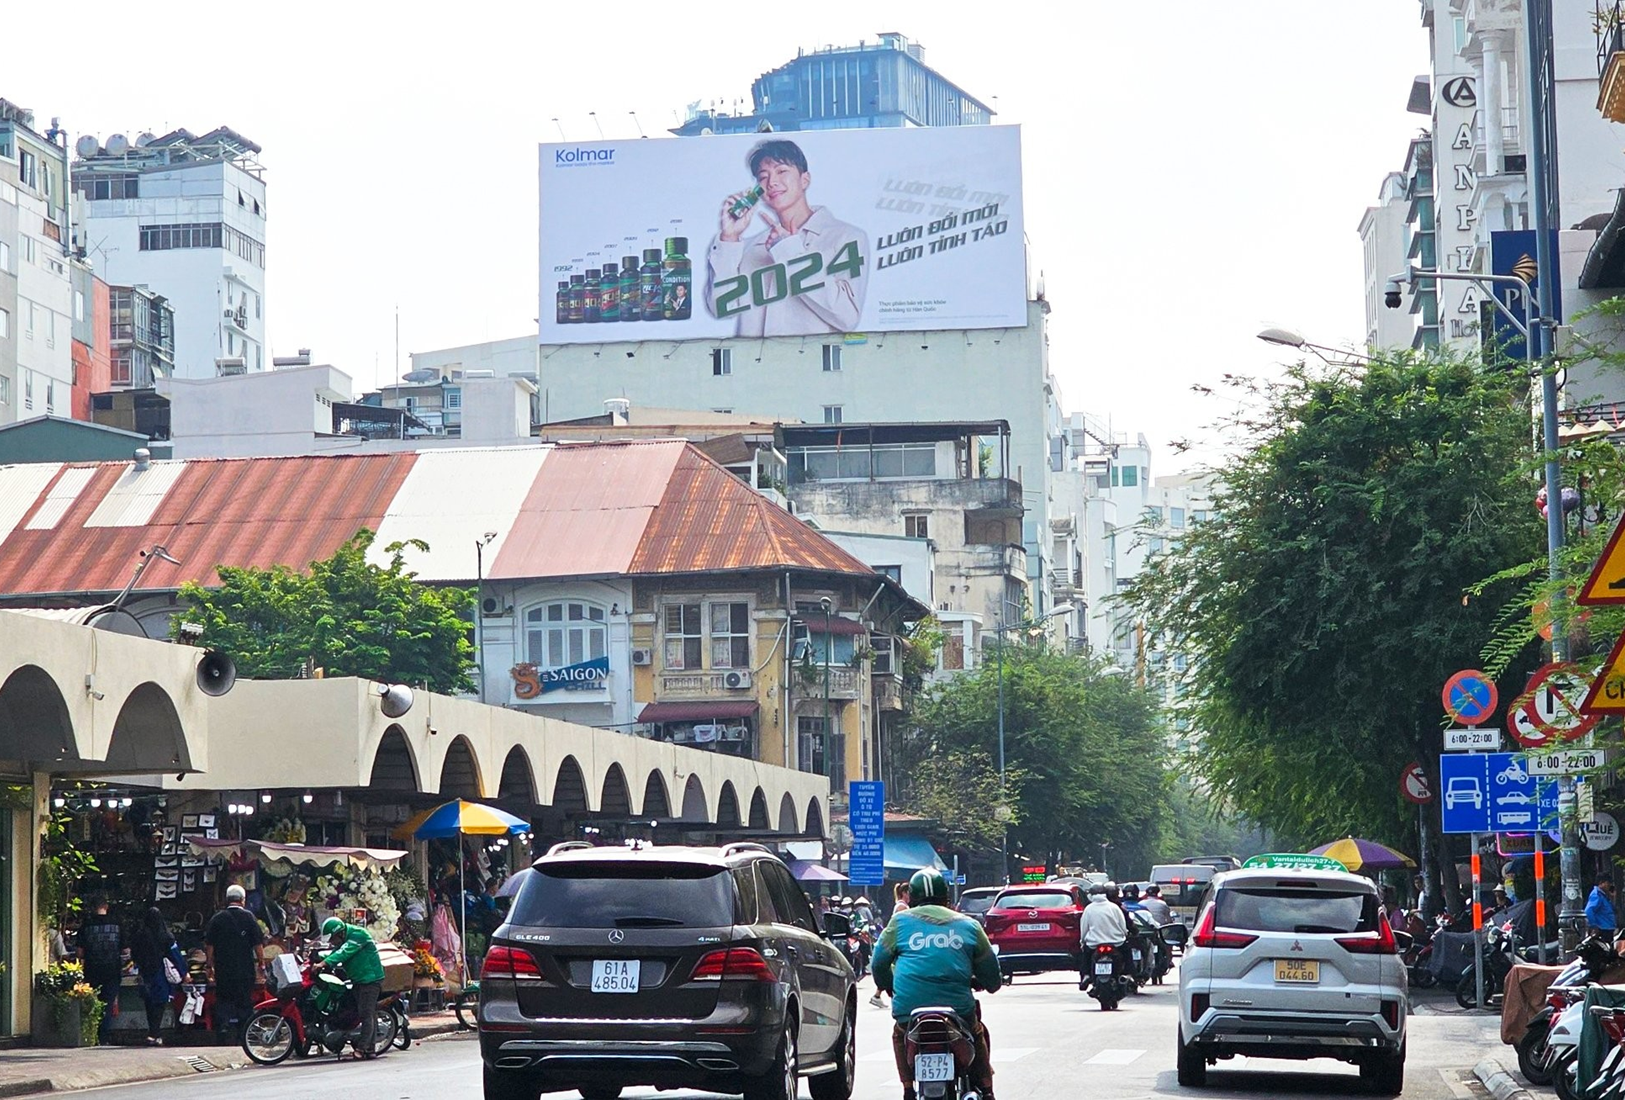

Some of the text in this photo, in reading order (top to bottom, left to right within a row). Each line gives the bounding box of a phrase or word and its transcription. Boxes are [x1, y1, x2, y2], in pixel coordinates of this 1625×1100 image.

[556, 147, 616, 163] Kolmar
[876, 202, 999, 251] LUÔN ĐỔI MỚI
[876, 245, 924, 271] LUÔN
[971, 220, 1008, 242] TÁO
[713, 240, 865, 319] 2024
[550, 667, 607, 681] SAIGON
[1541, 799, 1551, 808] XE
[908, 930, 964, 950] Grab
[604, 961, 628, 975] 61A
[1287, 960, 1307, 970] 50E
[1279, 970, 1315, 981] 044.60
[594, 976, 636, 990] 485.04
[921, 1055, 949, 1068] 52-P4
[921, 1067, 949, 1079] 8577
